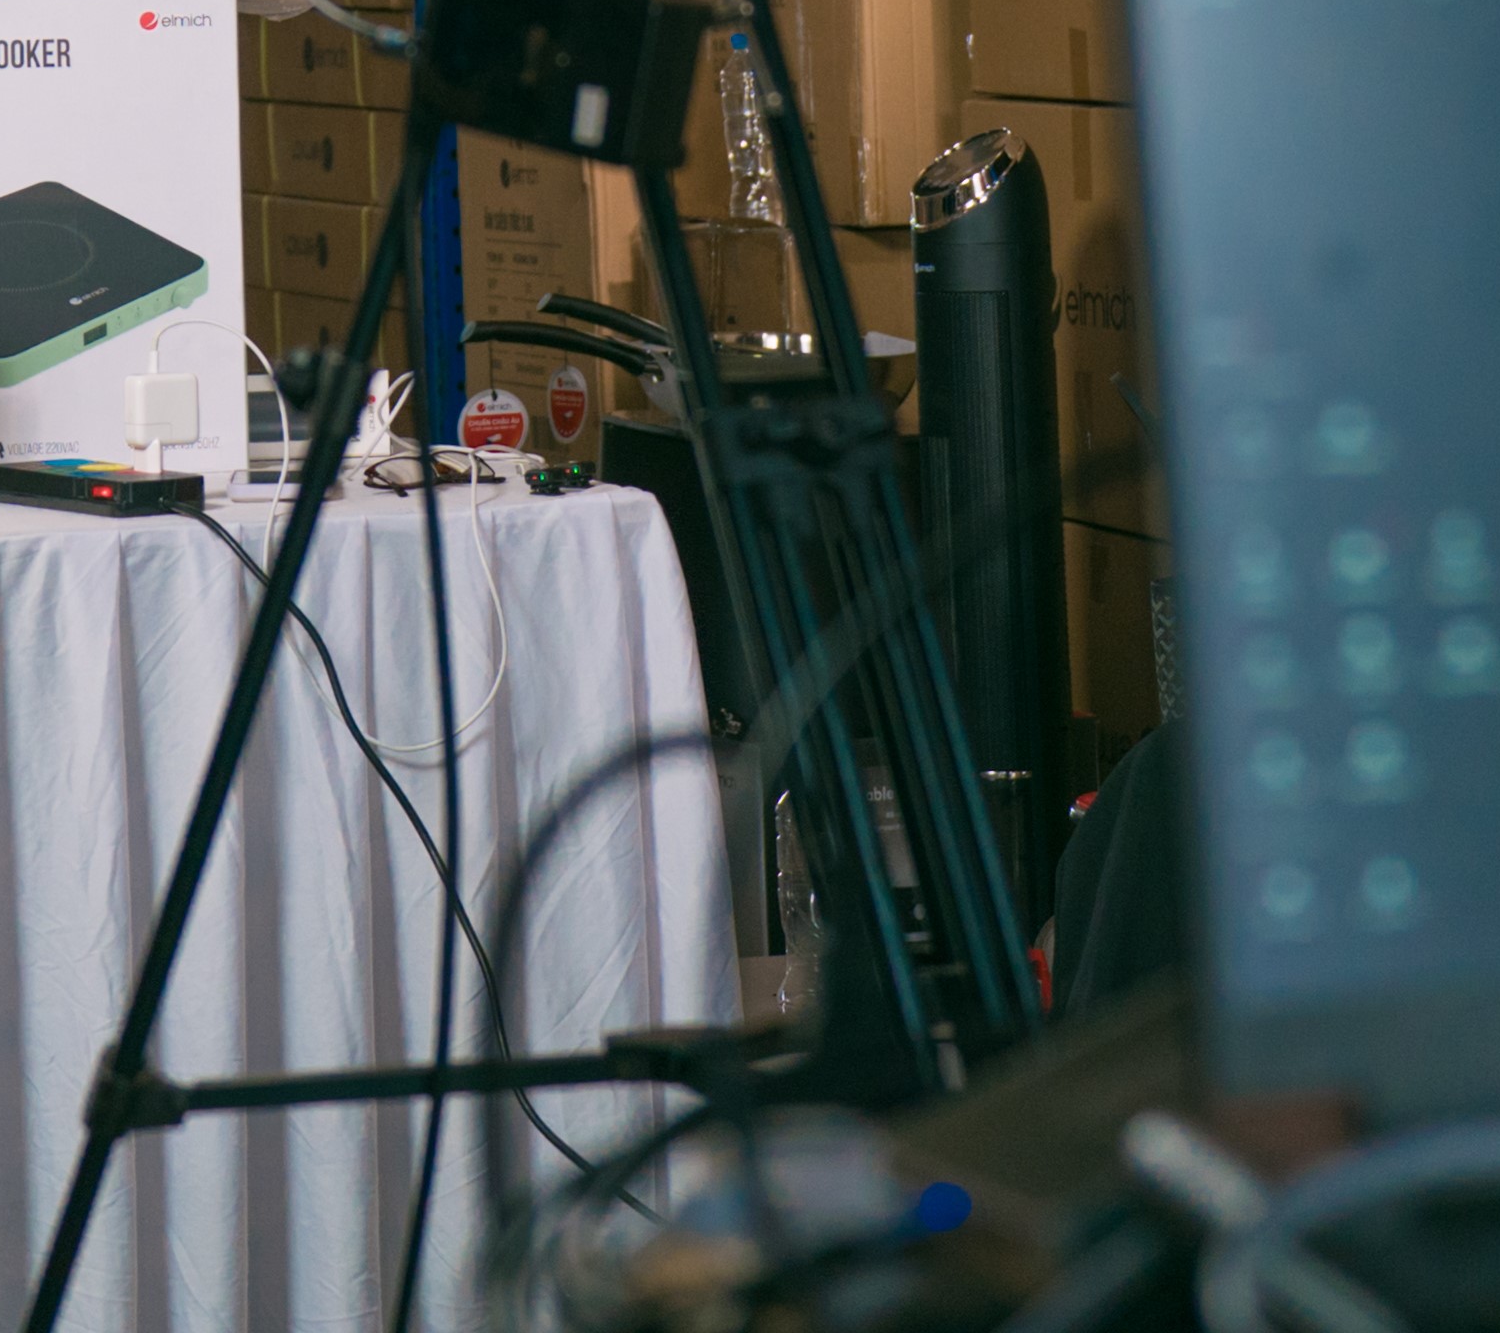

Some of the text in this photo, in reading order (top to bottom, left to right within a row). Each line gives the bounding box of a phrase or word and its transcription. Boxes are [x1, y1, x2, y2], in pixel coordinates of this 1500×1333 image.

[161, 13, 212, 28] elmich
[1065, 284, 1136, 331] elmich
[8, 440, 79, 456] VOLTAGE 220VAC
